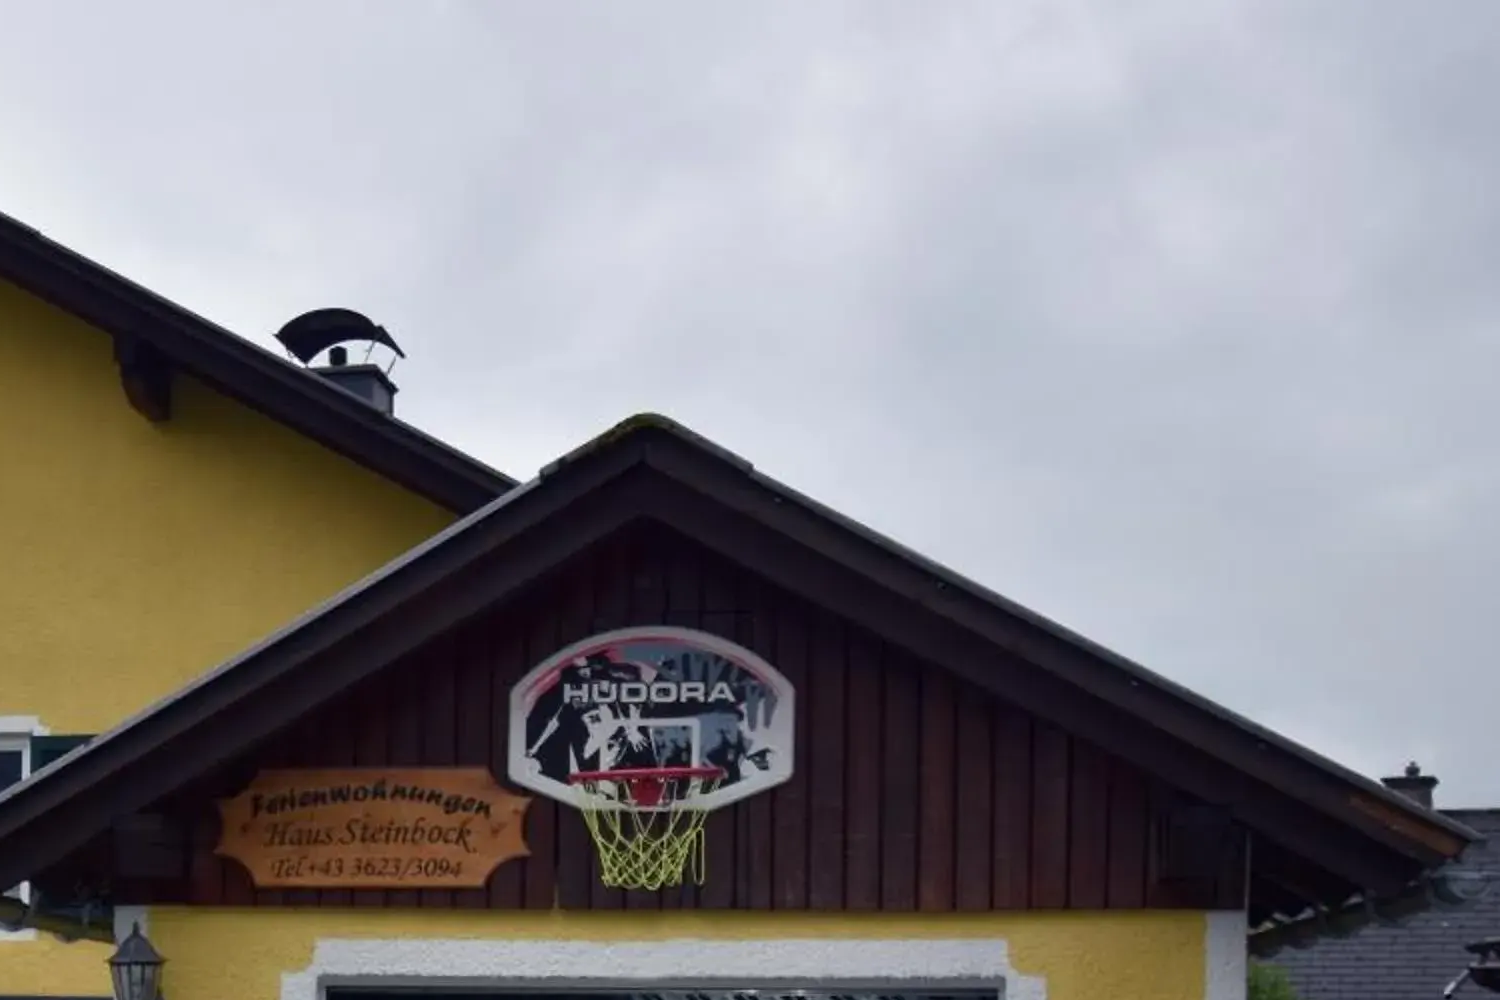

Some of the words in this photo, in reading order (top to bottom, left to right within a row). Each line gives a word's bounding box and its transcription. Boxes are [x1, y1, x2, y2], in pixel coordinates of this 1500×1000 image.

[563, 681, 736, 704] HUDORA
[252, 777, 492, 819] Ferienwohnungen
[263, 819, 333, 847] Haus
[337, 814, 473, 853] Steinbock
